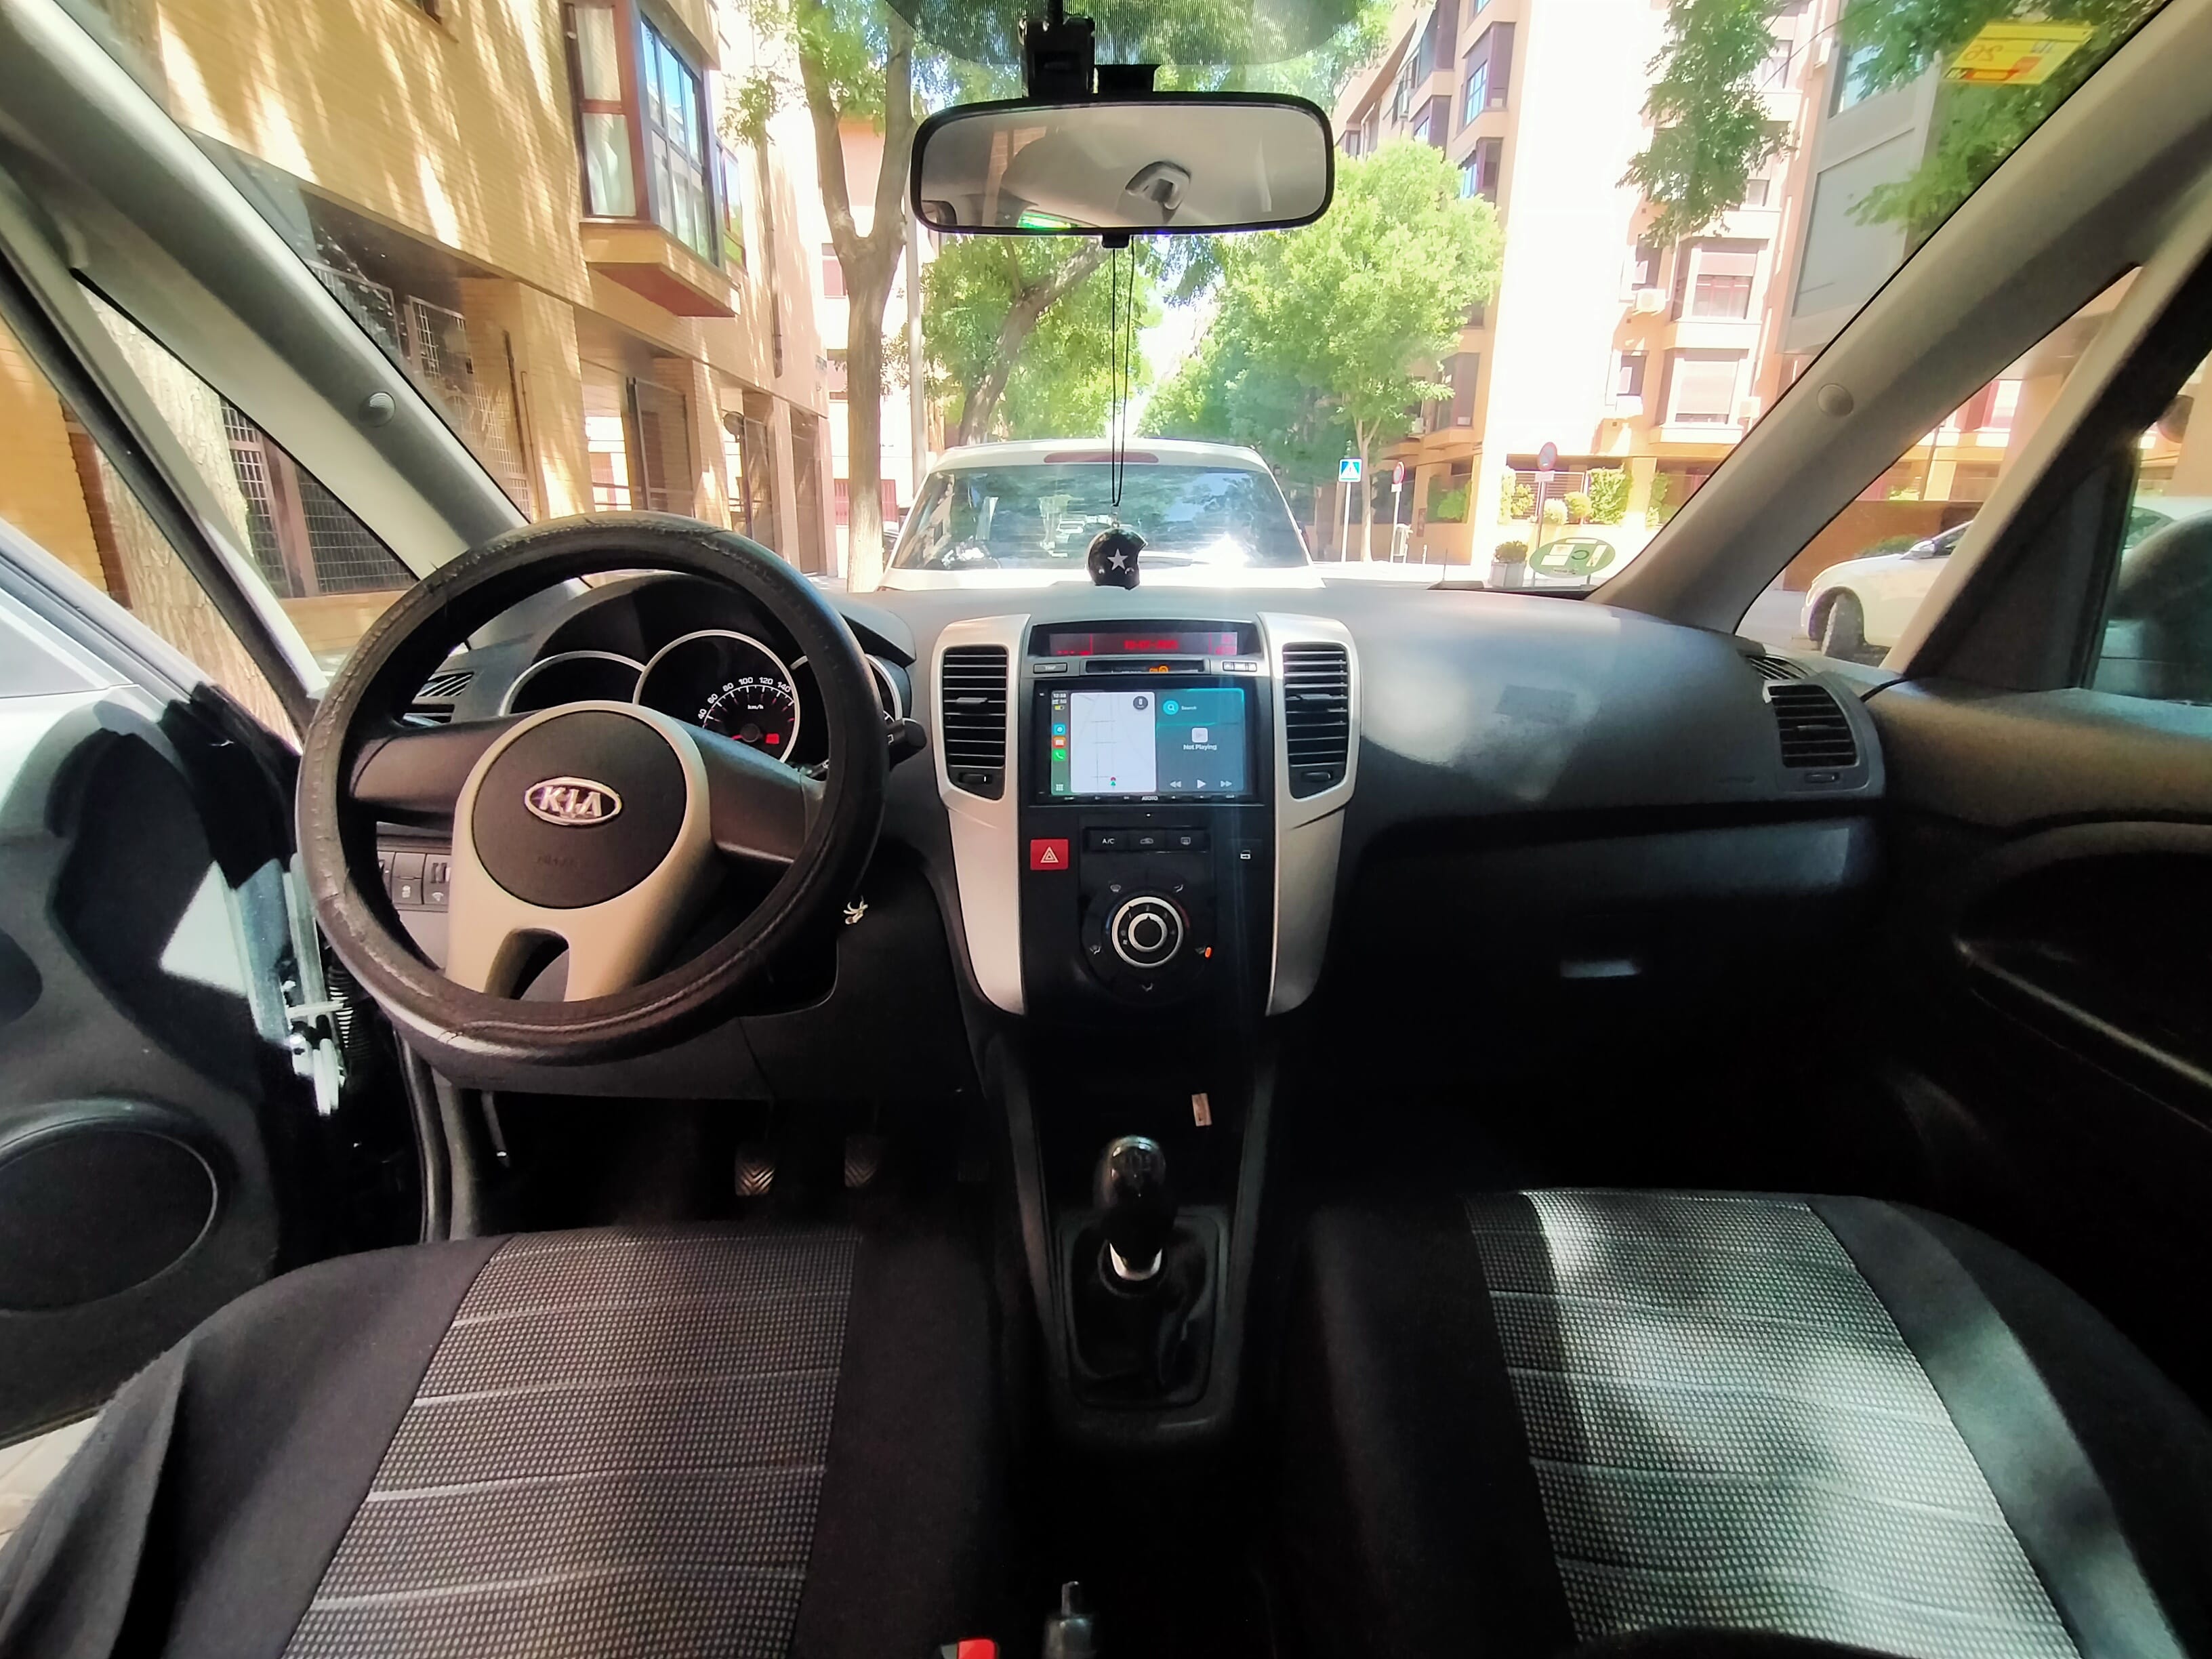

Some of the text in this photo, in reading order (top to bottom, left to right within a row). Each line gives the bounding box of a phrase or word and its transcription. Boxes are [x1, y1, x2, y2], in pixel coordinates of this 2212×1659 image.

[738, 676, 754, 685] 100
[759, 676, 774, 685] 120
[722, 682, 735, 692] 80
[777, 681, 792, 693] 140
[697, 708, 707, 720] 40
[539, 785, 602, 817] KIA
